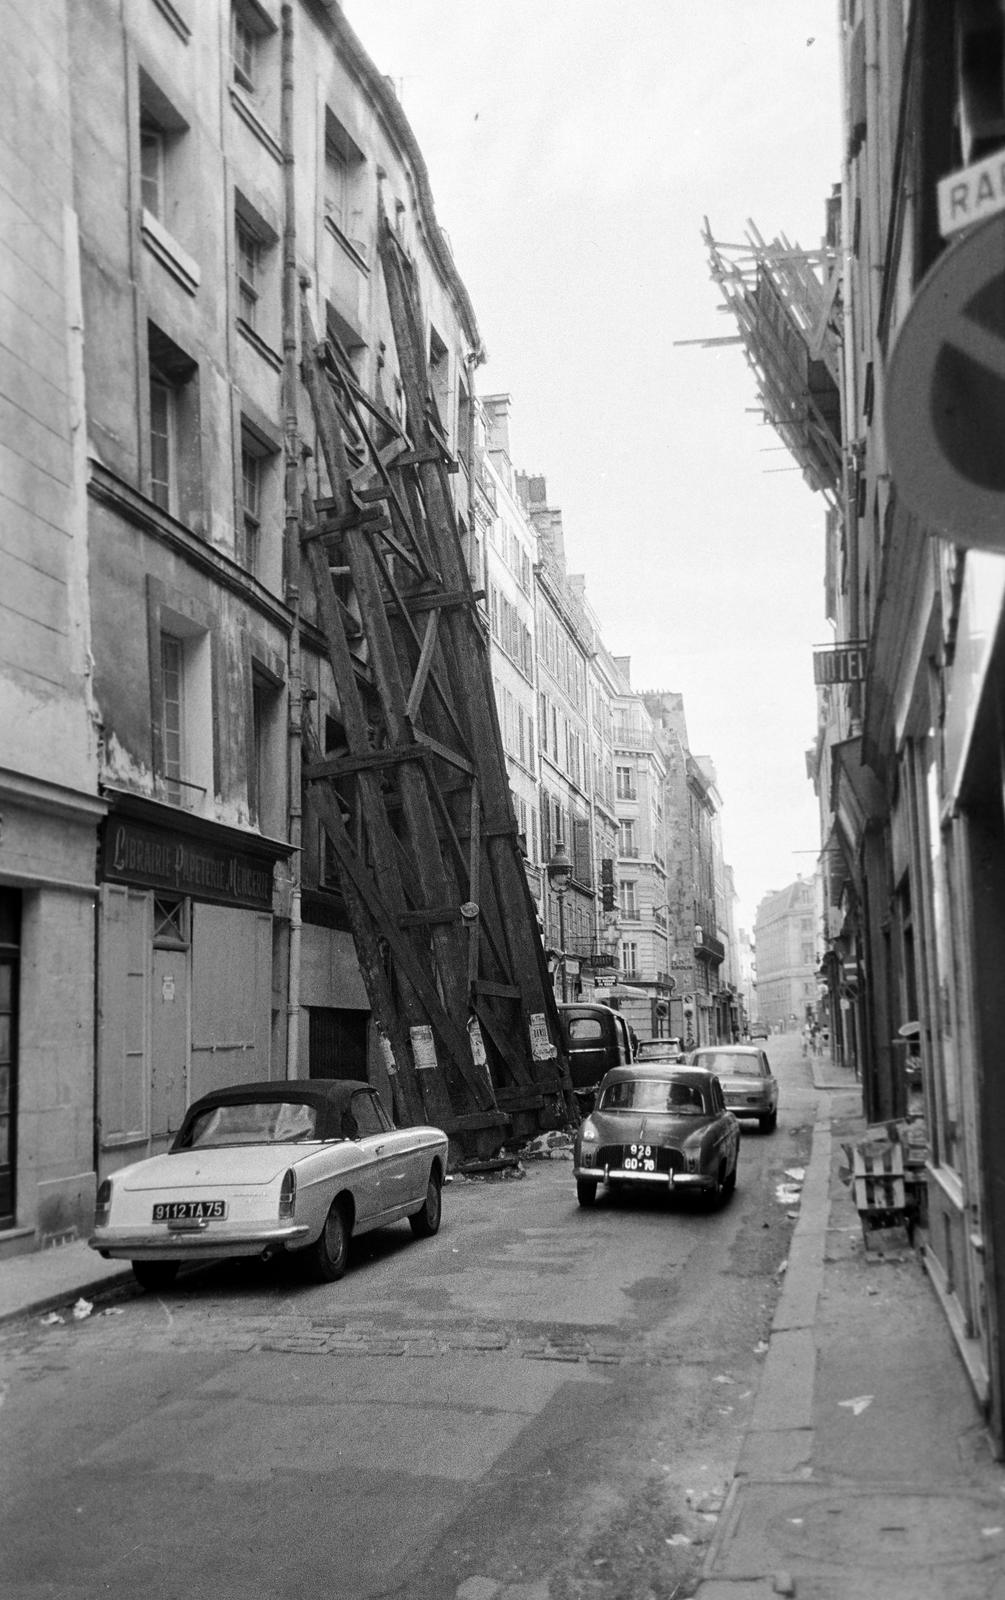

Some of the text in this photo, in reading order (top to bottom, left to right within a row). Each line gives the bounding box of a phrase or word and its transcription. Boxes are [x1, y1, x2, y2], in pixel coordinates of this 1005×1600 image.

[950, 163, 1005, 220] RA
[156, 1202, 222, 1219] 9112 TA 75
